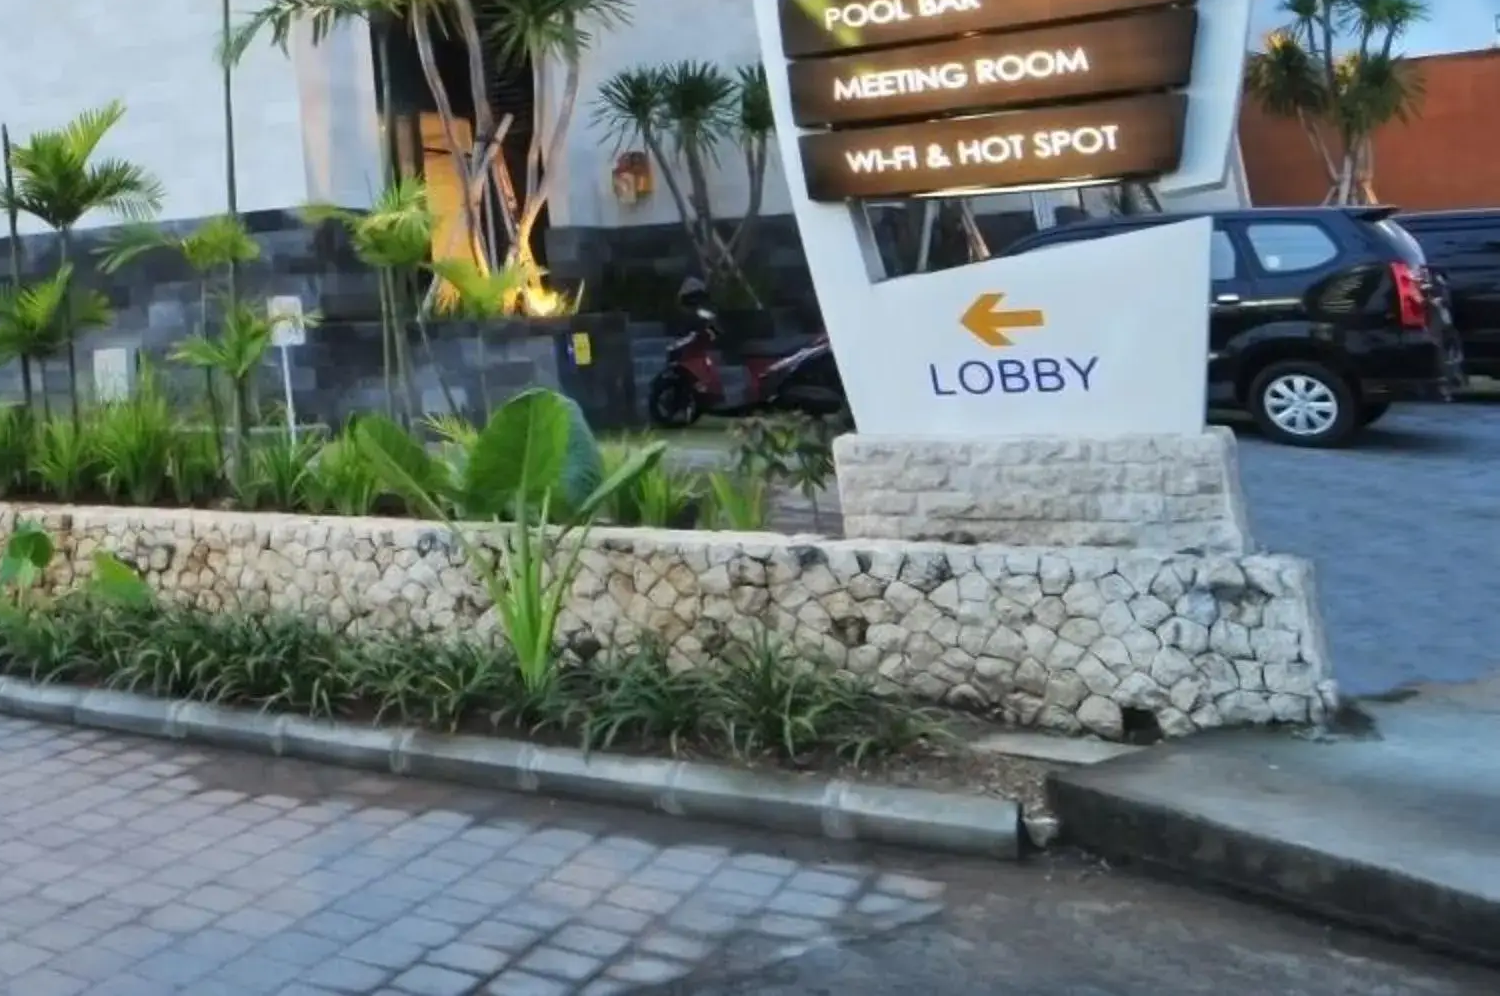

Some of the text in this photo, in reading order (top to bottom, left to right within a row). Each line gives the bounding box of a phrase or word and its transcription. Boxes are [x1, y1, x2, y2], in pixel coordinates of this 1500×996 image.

[833, 46, 1089, 101] MEETING ROOM
[846, 124, 1119, 174] WI-FI & HOT SPOT
[929, 355, 1099, 396] LOBBY
